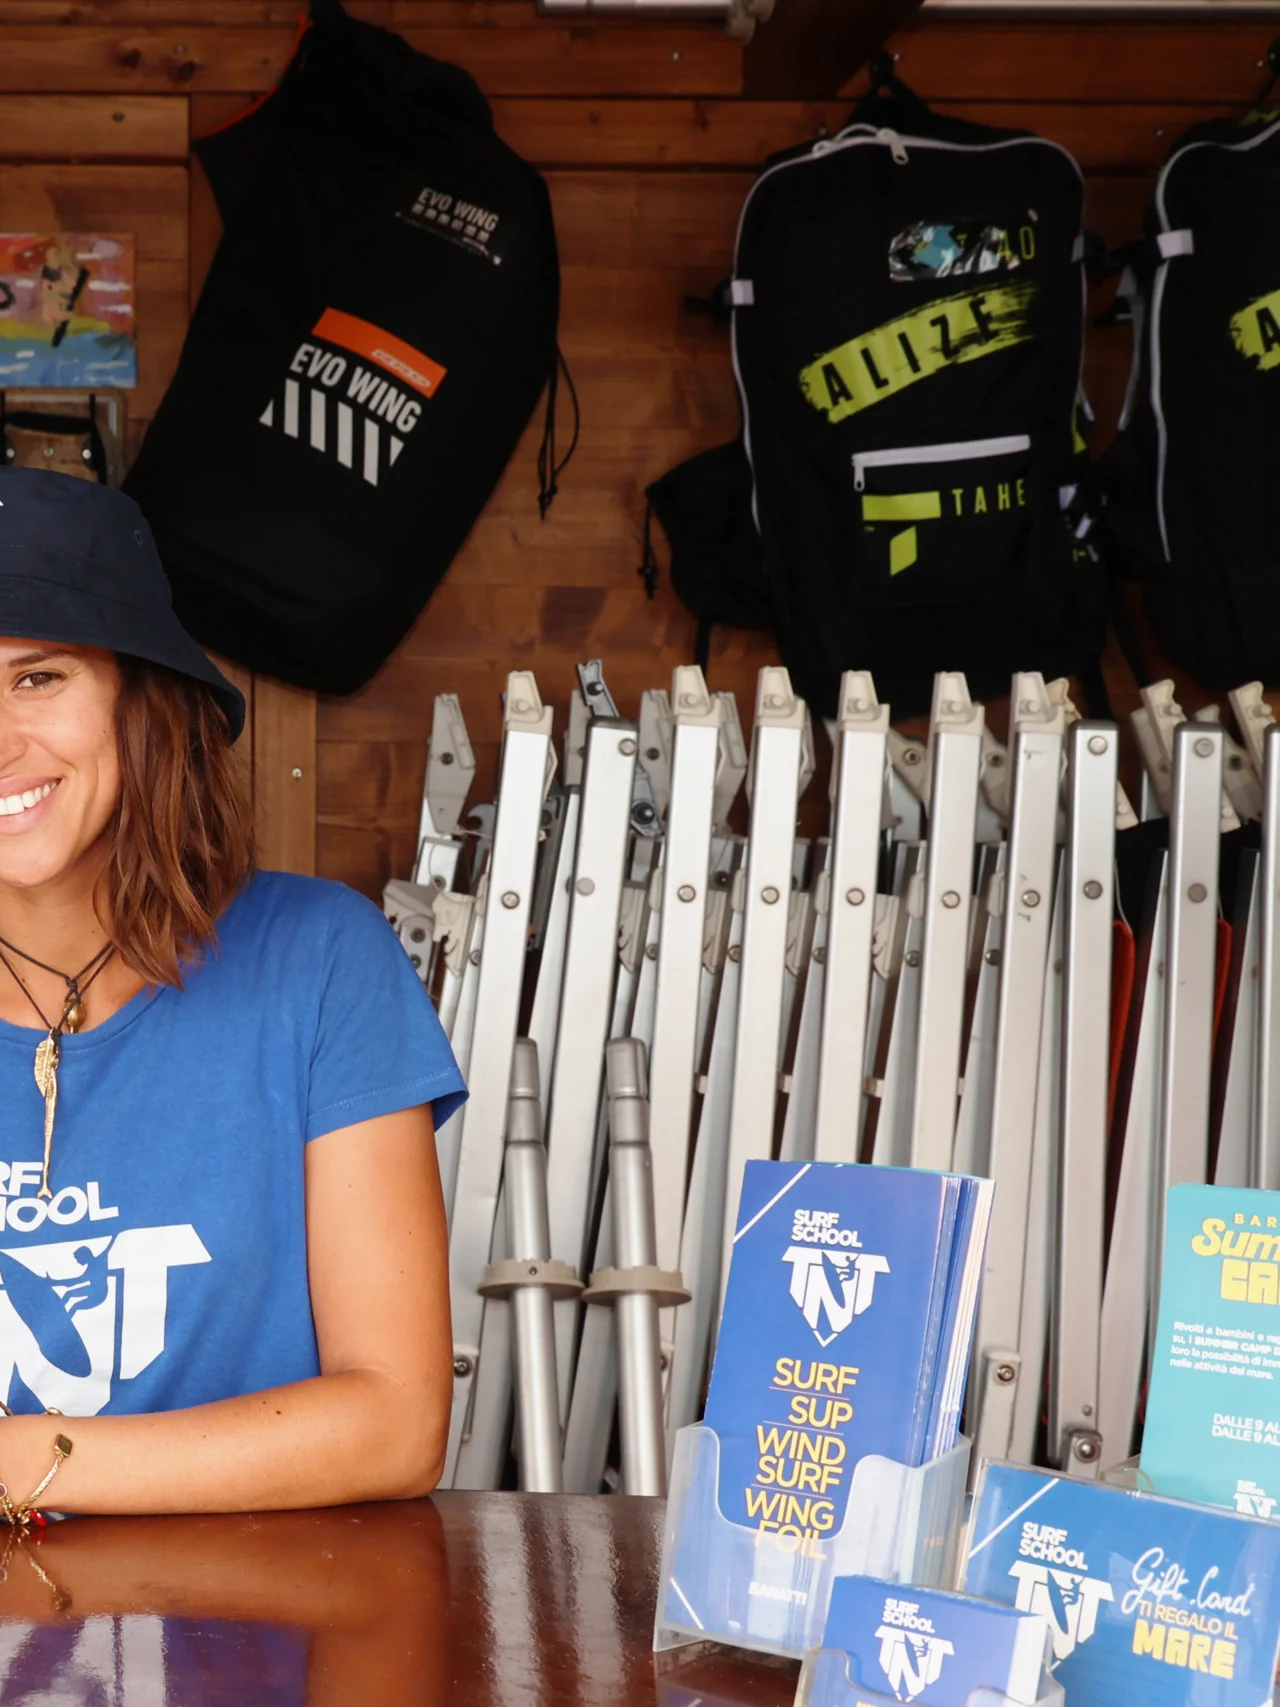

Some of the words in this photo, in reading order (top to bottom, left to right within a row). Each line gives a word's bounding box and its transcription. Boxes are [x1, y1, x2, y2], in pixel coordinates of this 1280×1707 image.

[418, 187, 453, 212] EVO
[454, 200, 499, 232] WING
[821, 294, 1003, 407] ALIZE
[290, 343, 347, 387] EVO
[346, 366, 422, 433] WING
[951, 479, 1026, 516] TAHE
[791, 1223, 863, 1249] SCHOOL
[793, 1208, 840, 1229] SURF
[782, 1245, 891, 1346] TNT
[1174, 1321, 1204, 1334] Rivolti
[1206, 1327, 1213, 1335] a
[1215, 1327, 1255, 1340] bambini
[1257, 1334, 1264, 1342] e
[1241, 1342, 1272, 1354] CAMP
[1170, 1358, 1192, 1368] nelle
[1194, 1361, 1228, 1373] attività
[1246, 1369, 1274, 1380] mare.
[1171, 1345, 1190, 1356] loro
[1191, 1348, 1200, 1357] la
[1201, 1351, 1250, 1364] possibilità
[1251, 1356, 1262, 1366] di
[773, 1357, 860, 1393] SURF
[788, 1395, 854, 1429] SUP
[1213, 1413, 1254, 1430] DALLE
[1254, 1419, 1264, 1431] 9
[756, 1425, 846, 1465] WIND
[1211, 1424, 1253, 1442] DALLE
[1253, 1431, 1263, 1443] 9
[756, 1455, 843, 1491] SURF
[745, 1488, 836, 1531] WING
[754, 1519, 827, 1560] FOIL
[1022, 1520, 1068, 1547] SURF
[1018, 1538, 1088, 1571] SCHOOL
[748, 1581, 808, 1605] BARATTI
[1121, 1547, 1189, 1615] Gift
[1191, 1566, 1256, 1616] Card
[882, 1608, 935, 1634] SCHOOL
[885, 1597, 920, 1614] SURF
[1008, 1559, 1115, 1663] TNT
[1138, 1599, 1153, 1617] TI
[1154, 1604, 1222, 1635] REGALO
[1224, 1621, 1239, 1640] IL
[874, 1625, 955, 1702] TNT
[1132, 1619, 1237, 1680] MARE
